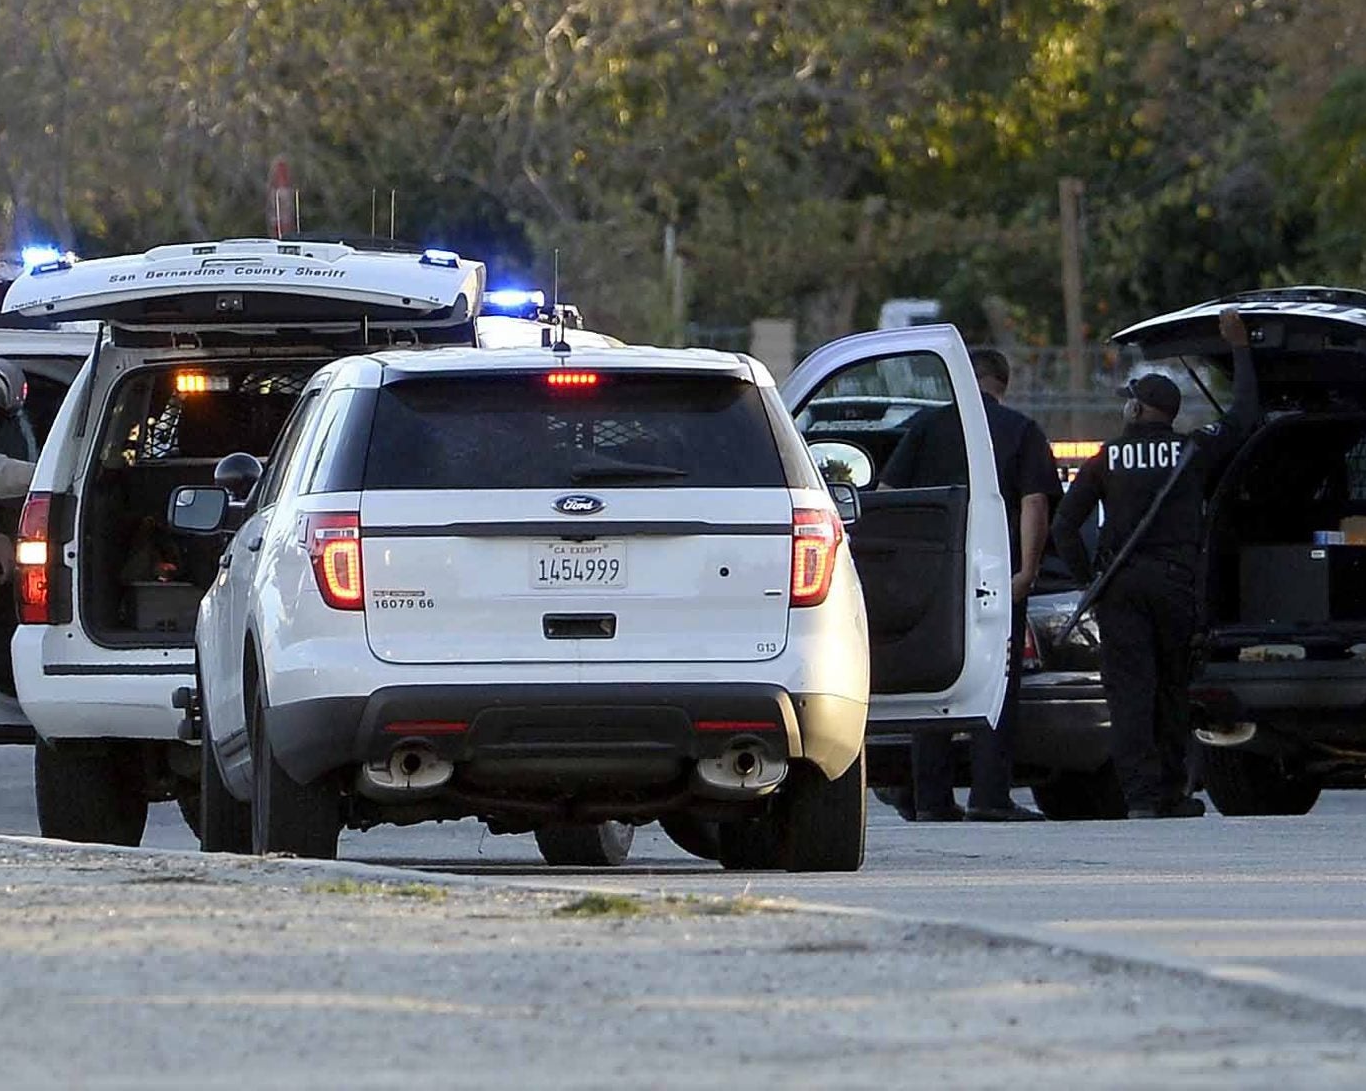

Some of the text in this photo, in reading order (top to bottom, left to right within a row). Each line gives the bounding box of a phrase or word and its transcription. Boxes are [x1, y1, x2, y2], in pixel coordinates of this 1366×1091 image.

[109, 267, 346, 283] San Bernardino County Sheriff
[1108, 442, 1181, 470] POLICE
[563, 497, 594, 510] Ford
[538, 559, 620, 581] 1454999
[375, 599, 414, 609] 16079
[757, 642, 777, 652] G13
